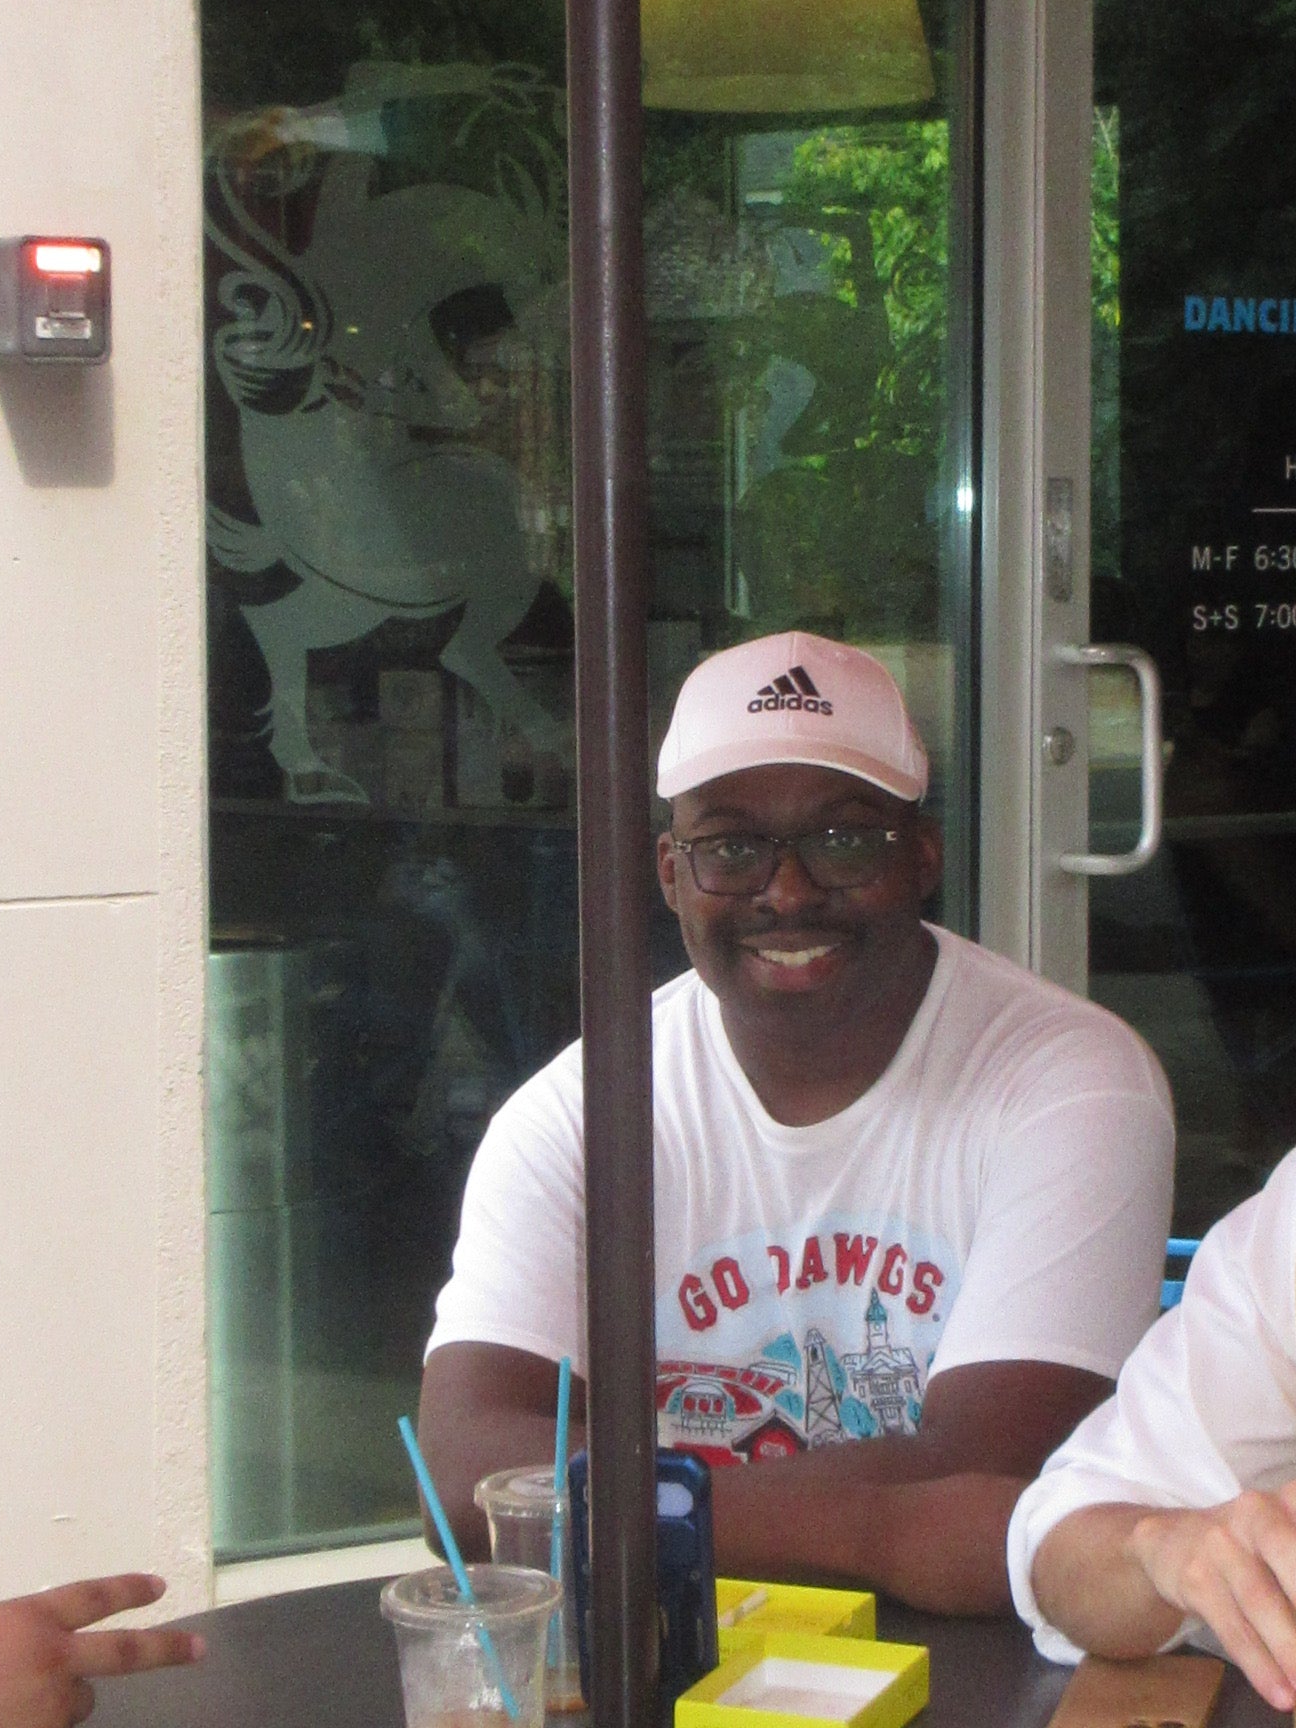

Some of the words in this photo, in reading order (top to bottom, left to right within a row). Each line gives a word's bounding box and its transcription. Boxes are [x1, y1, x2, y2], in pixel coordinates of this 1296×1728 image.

[1191, 545, 1239, 571] M-F
[1193, 605, 1239, 630] S+S
[747, 692, 833, 715] adidas
[678, 1256, 750, 1332] GO
